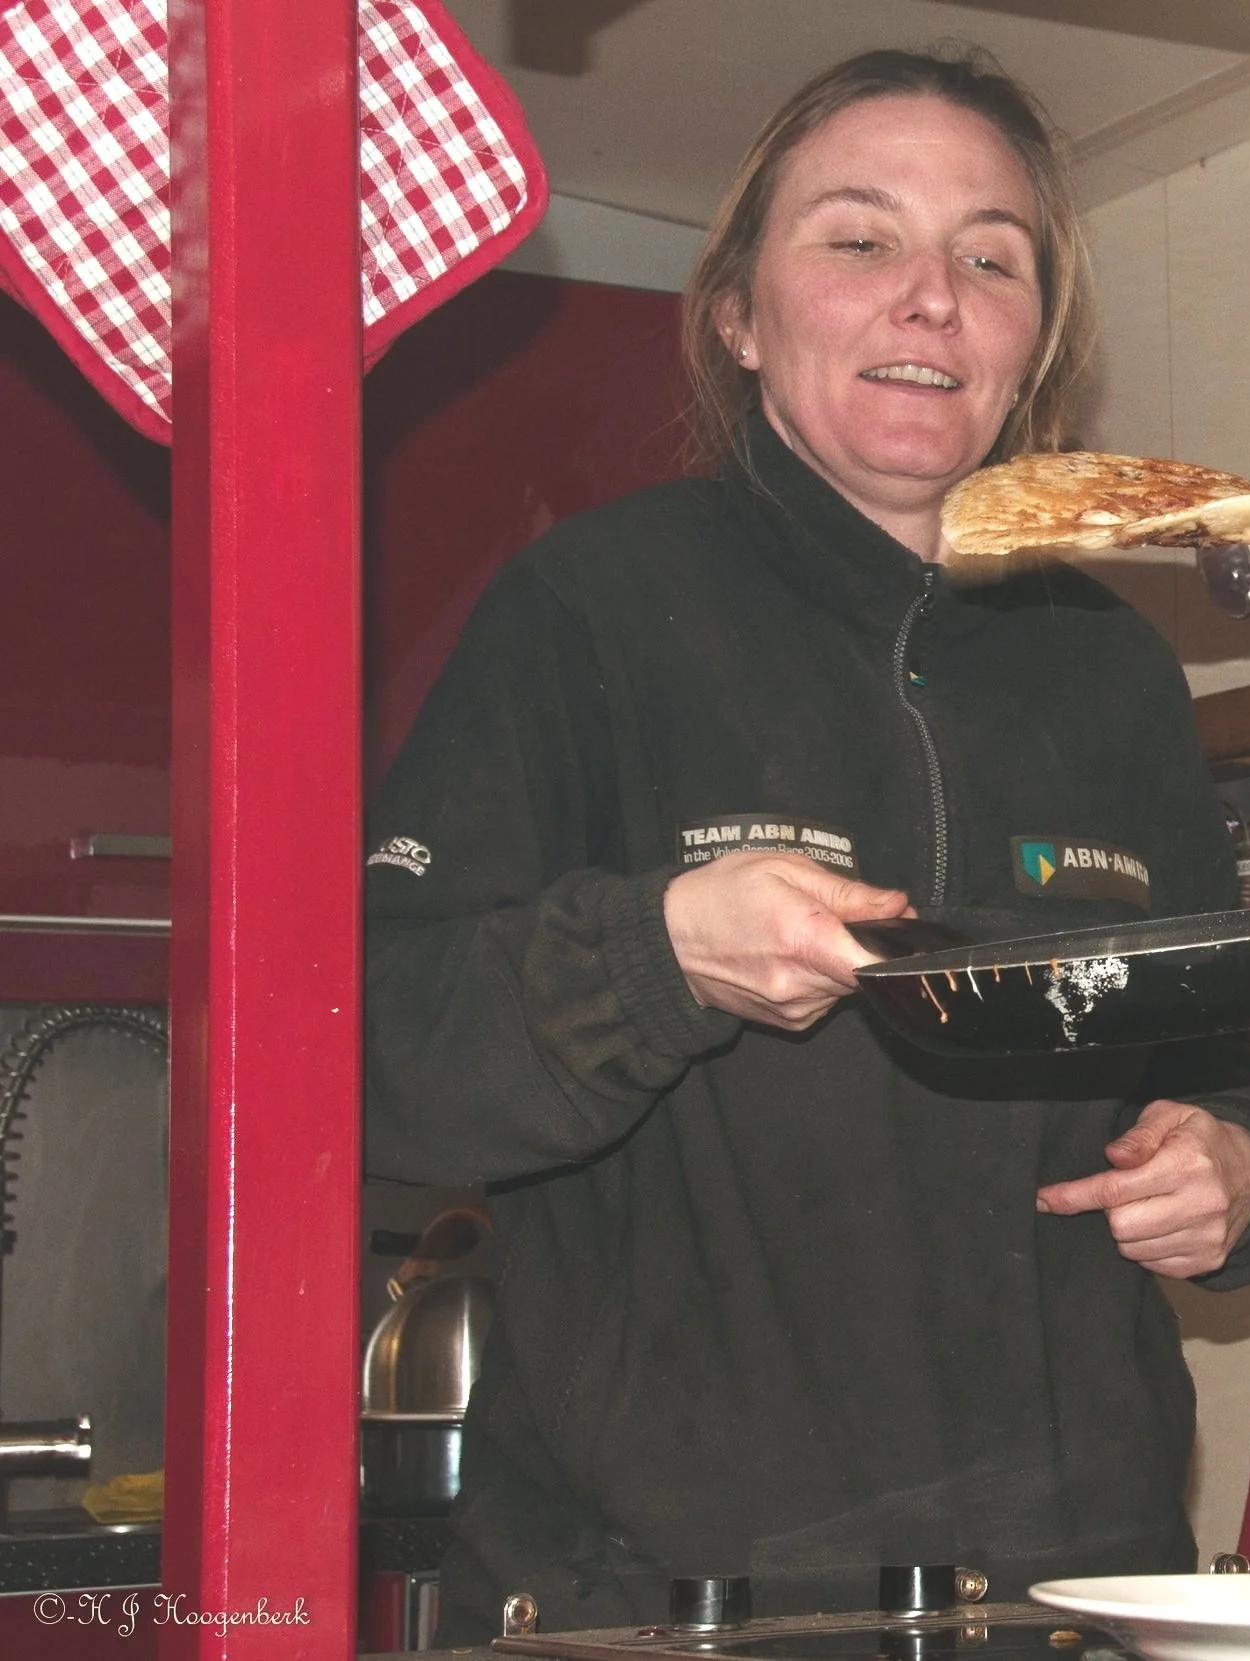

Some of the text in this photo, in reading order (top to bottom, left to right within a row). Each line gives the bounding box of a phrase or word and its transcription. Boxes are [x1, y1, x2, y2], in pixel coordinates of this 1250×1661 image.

[682, 824, 852, 853] TEAM ABN AMRO
[684, 851, 693, 864] in
[694, 849, 711, 862] the
